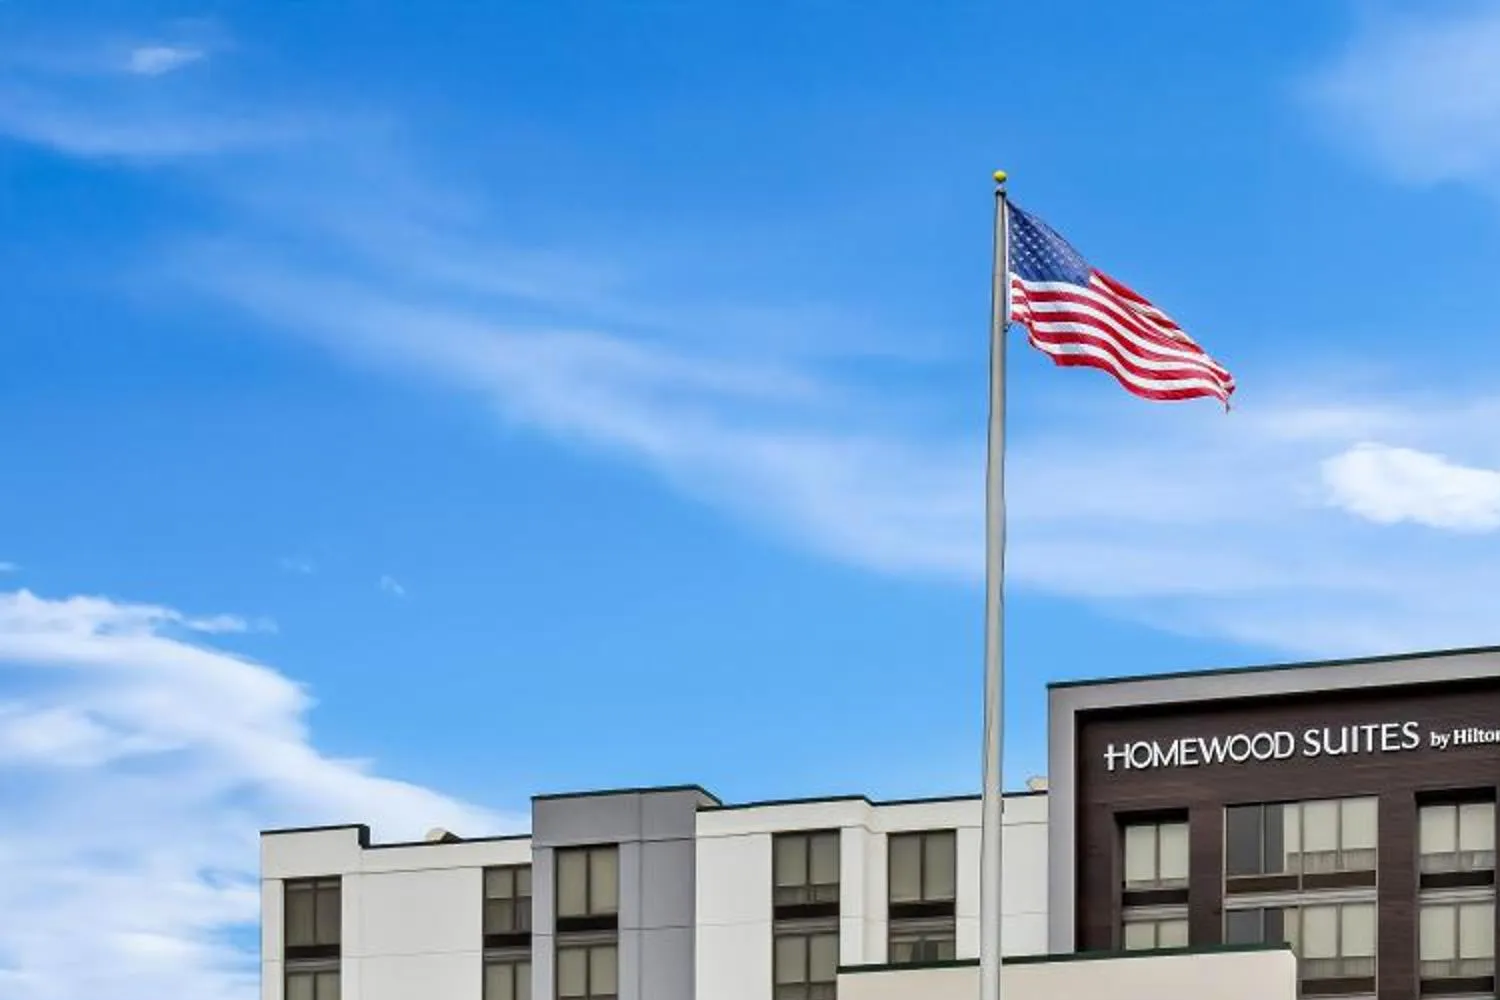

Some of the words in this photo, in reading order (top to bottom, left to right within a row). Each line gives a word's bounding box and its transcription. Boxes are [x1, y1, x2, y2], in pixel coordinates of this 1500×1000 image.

[1103, 731, 1295, 771] HOMEWOOD
[1302, 721, 1420, 757] SUITES
[1429, 731, 1450, 749] by
